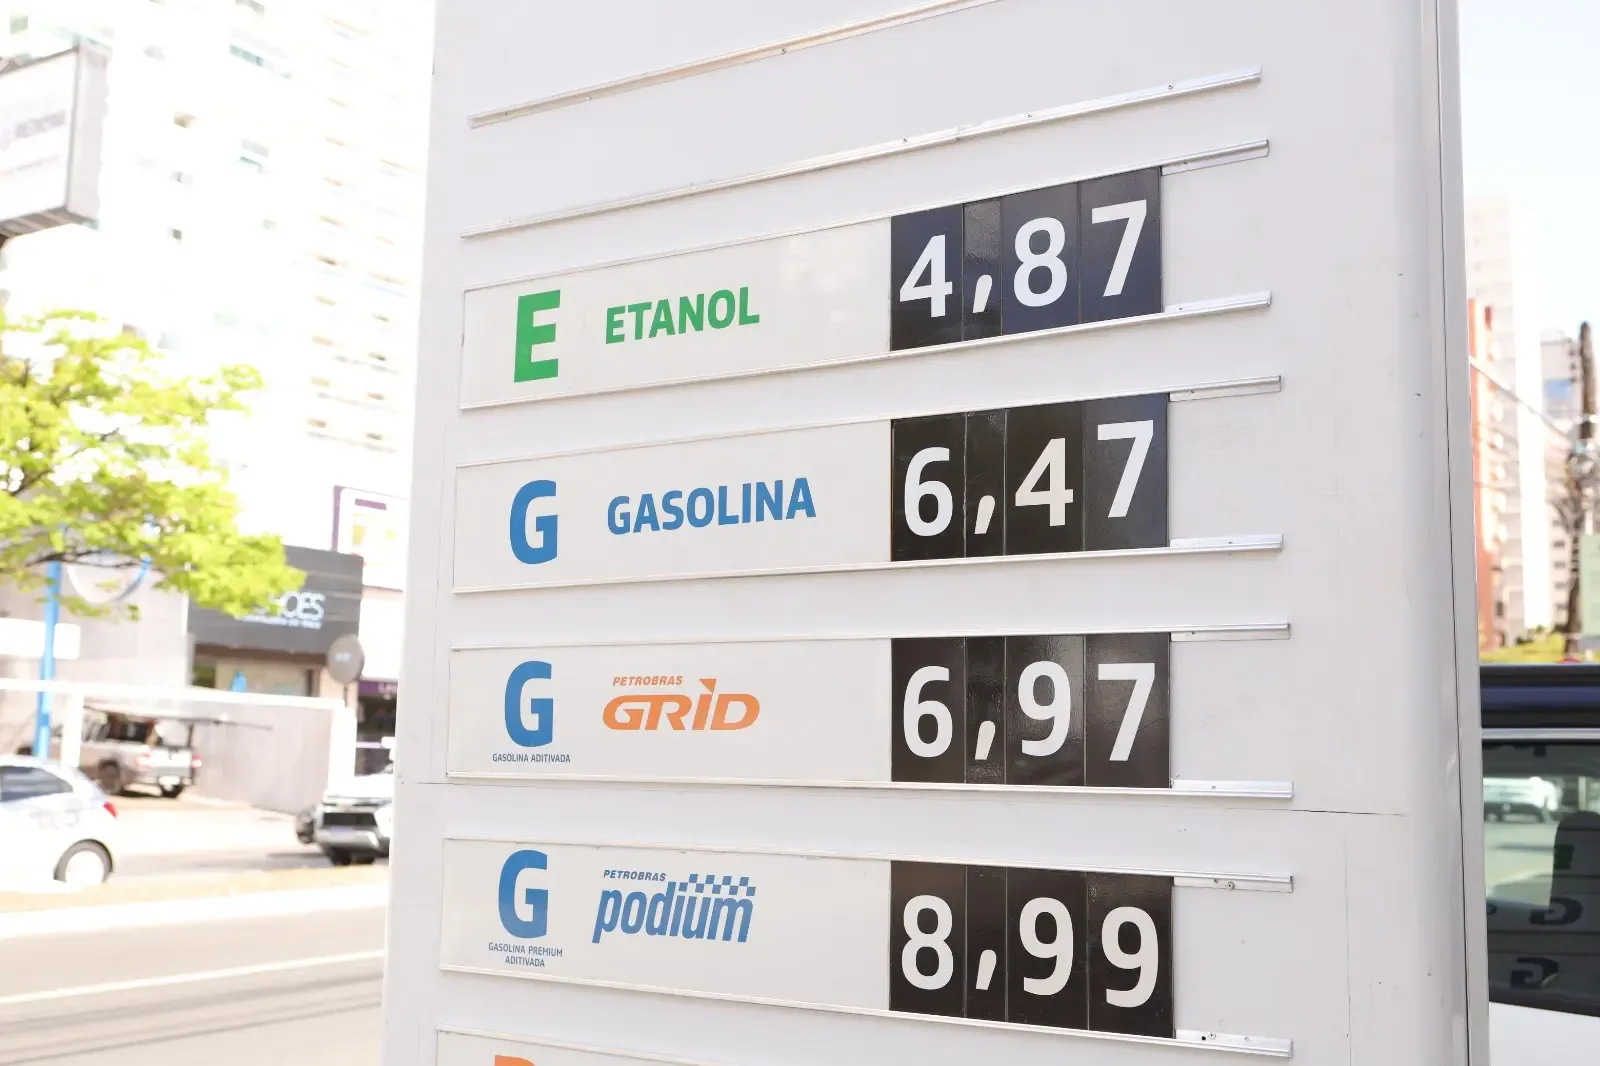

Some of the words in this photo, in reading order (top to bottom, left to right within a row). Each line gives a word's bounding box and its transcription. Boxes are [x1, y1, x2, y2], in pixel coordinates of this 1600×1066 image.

[900, 200, 1147, 318] 4,87
[513, 290, 561, 382] E
[605, 287, 760, 344] ETANOL
[607, 477, 816, 535] GASOLINA
[904, 419, 1154, 537] 6,47
[509, 480, 558, 565] G
[504, 660, 554, 748] G
[602, 678, 761, 731] GRID
[612, 675, 684, 687] PETROBRAS
[903, 660, 1155, 762] 6,97
[492, 753, 529, 763] GASOLINA
[530, 753, 571, 763] ADITIVADA
[498, 849, 549, 939] G
[603, 869, 667, 882] PETROBRAS
[592, 878, 756, 944] podium
[488, 942, 526, 955] GASOLINA
[528, 945, 563, 957] PREMIUM
[505, 955, 546, 967] ADITIVADA
[902, 895, 1159, 1008] 8,99
